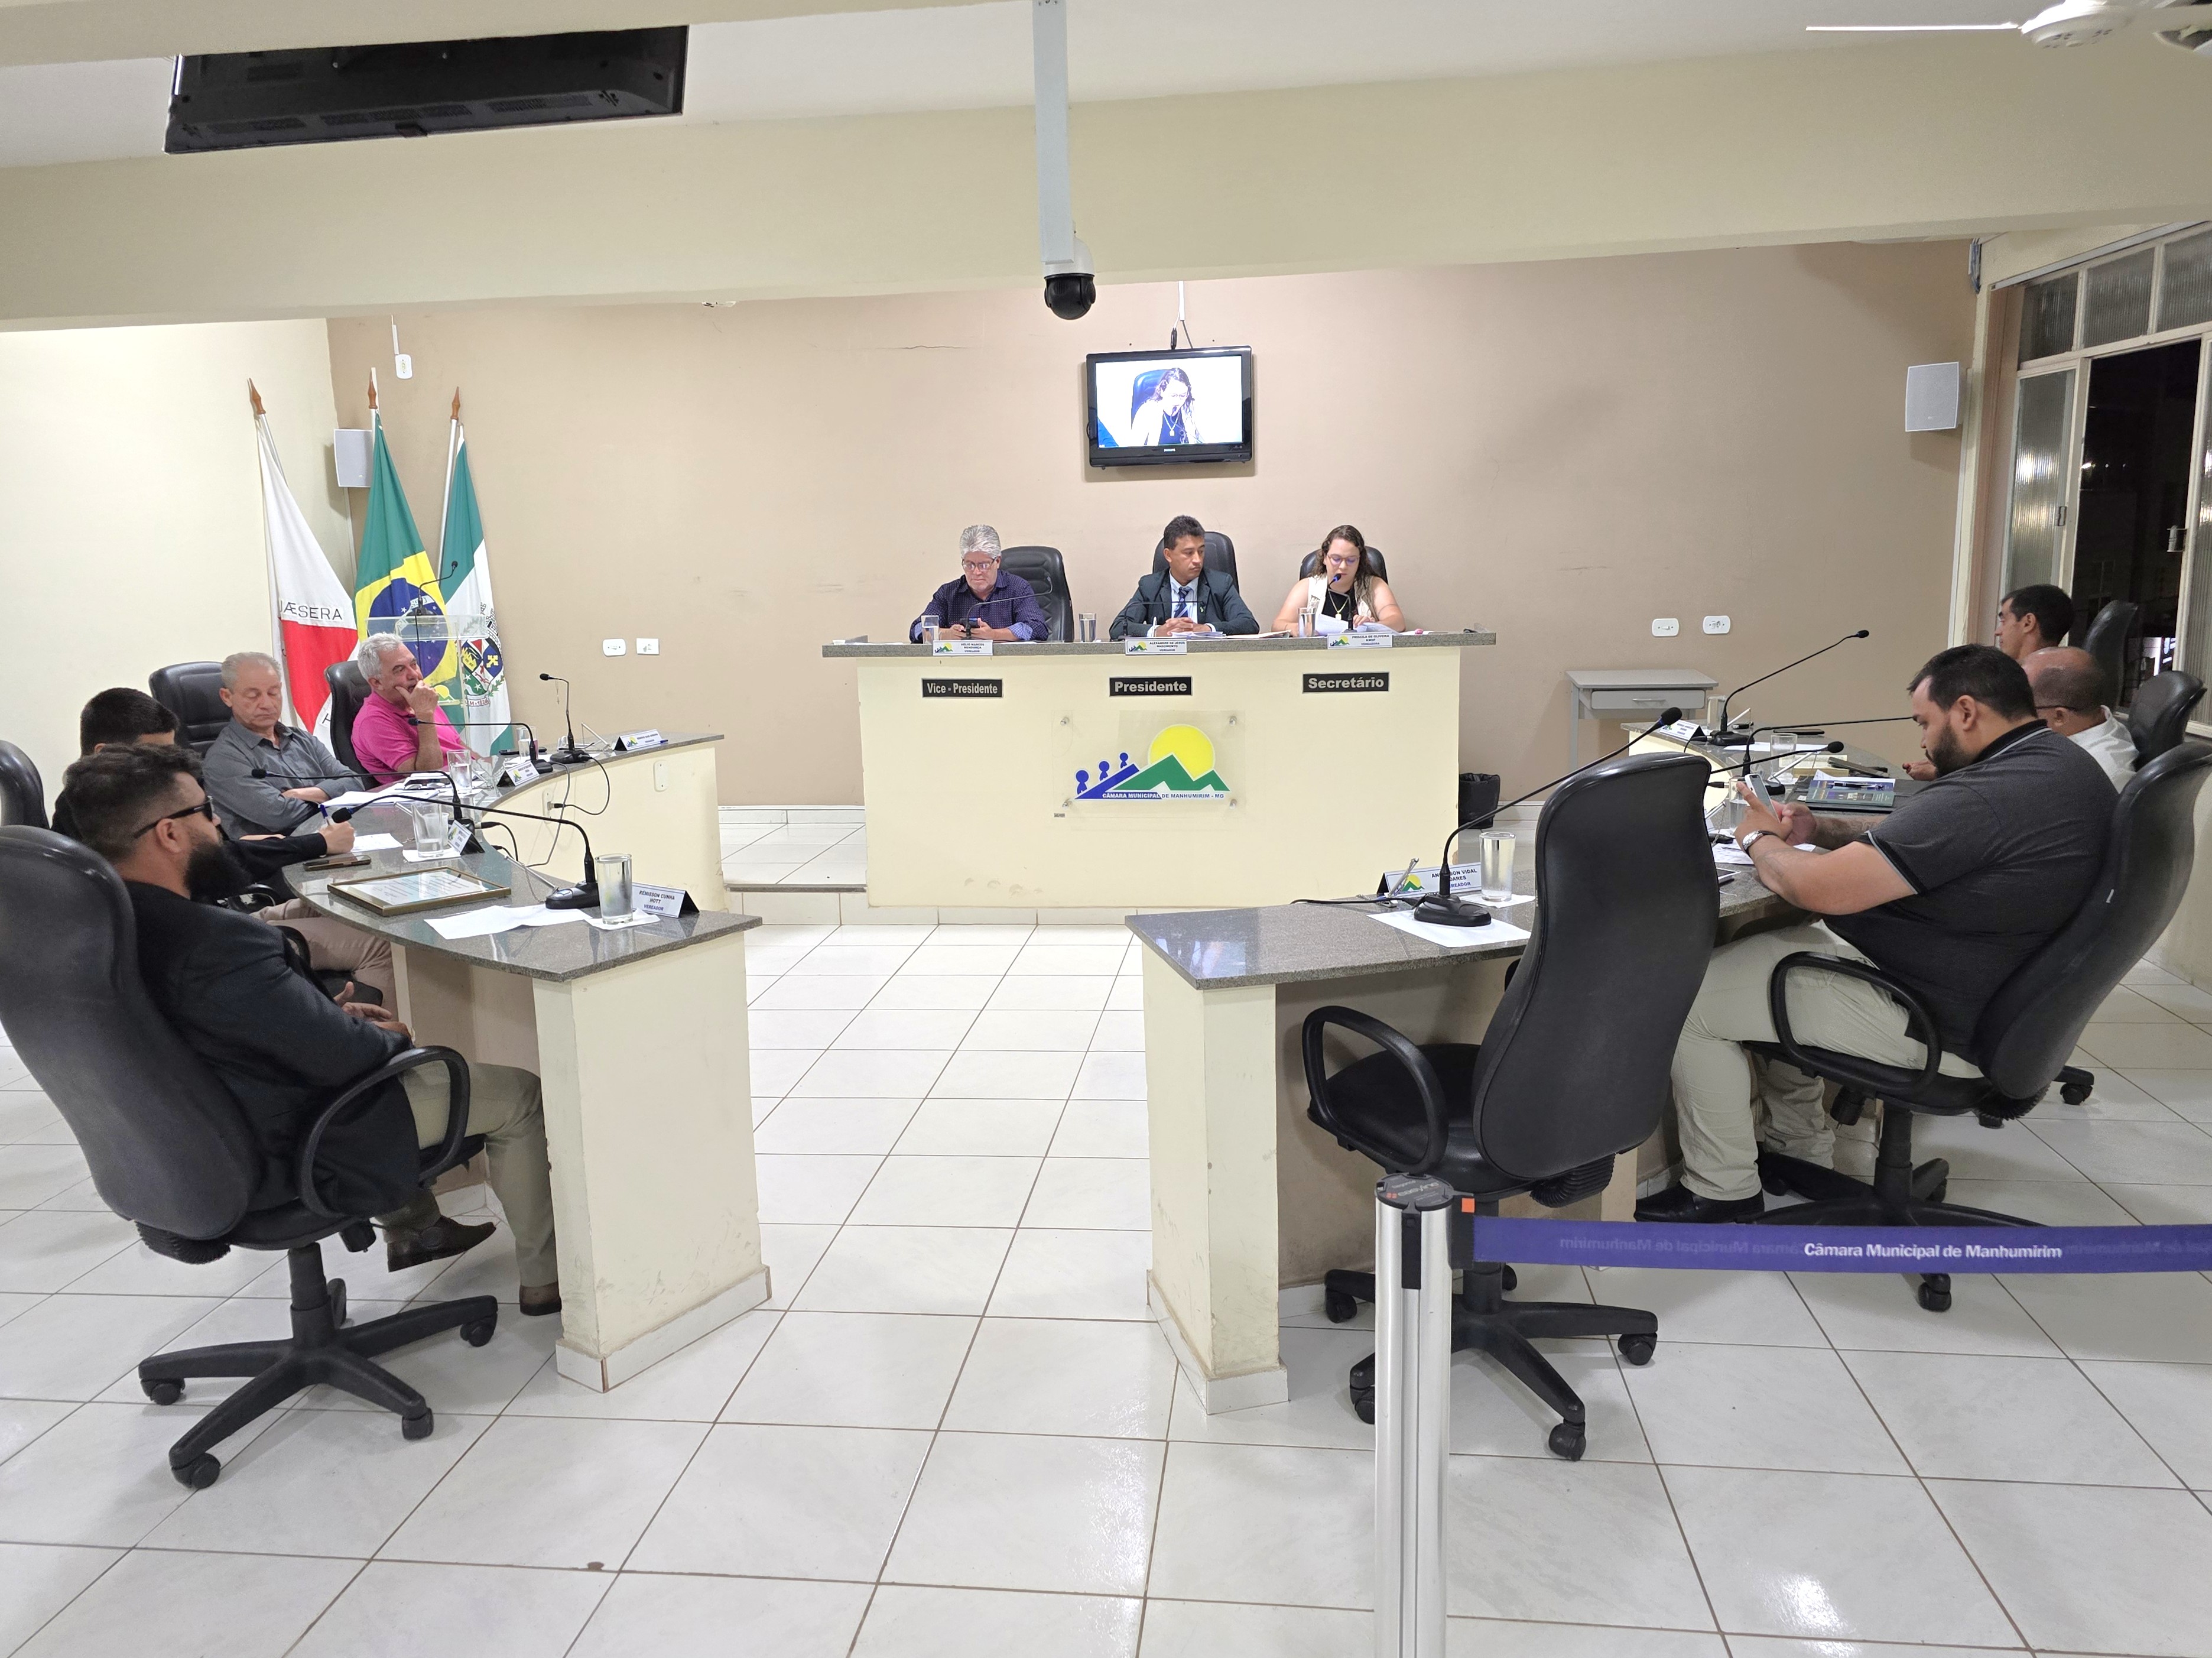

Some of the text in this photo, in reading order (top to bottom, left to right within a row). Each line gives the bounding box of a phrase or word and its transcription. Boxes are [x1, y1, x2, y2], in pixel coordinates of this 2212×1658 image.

[927, 683, 946, 693] Vice
[953, 683, 998, 694] Presidente
[1115, 680, 1187, 692] Presidente
[1308, 676, 1385, 689] Secretário
[1804, 1243, 1863, 1257] Câmara
[1866, 1244, 1940, 1260] Municipal
[1943, 1244, 1962, 1257] de
[1965, 1245, 2062, 1258] Manhumirim
